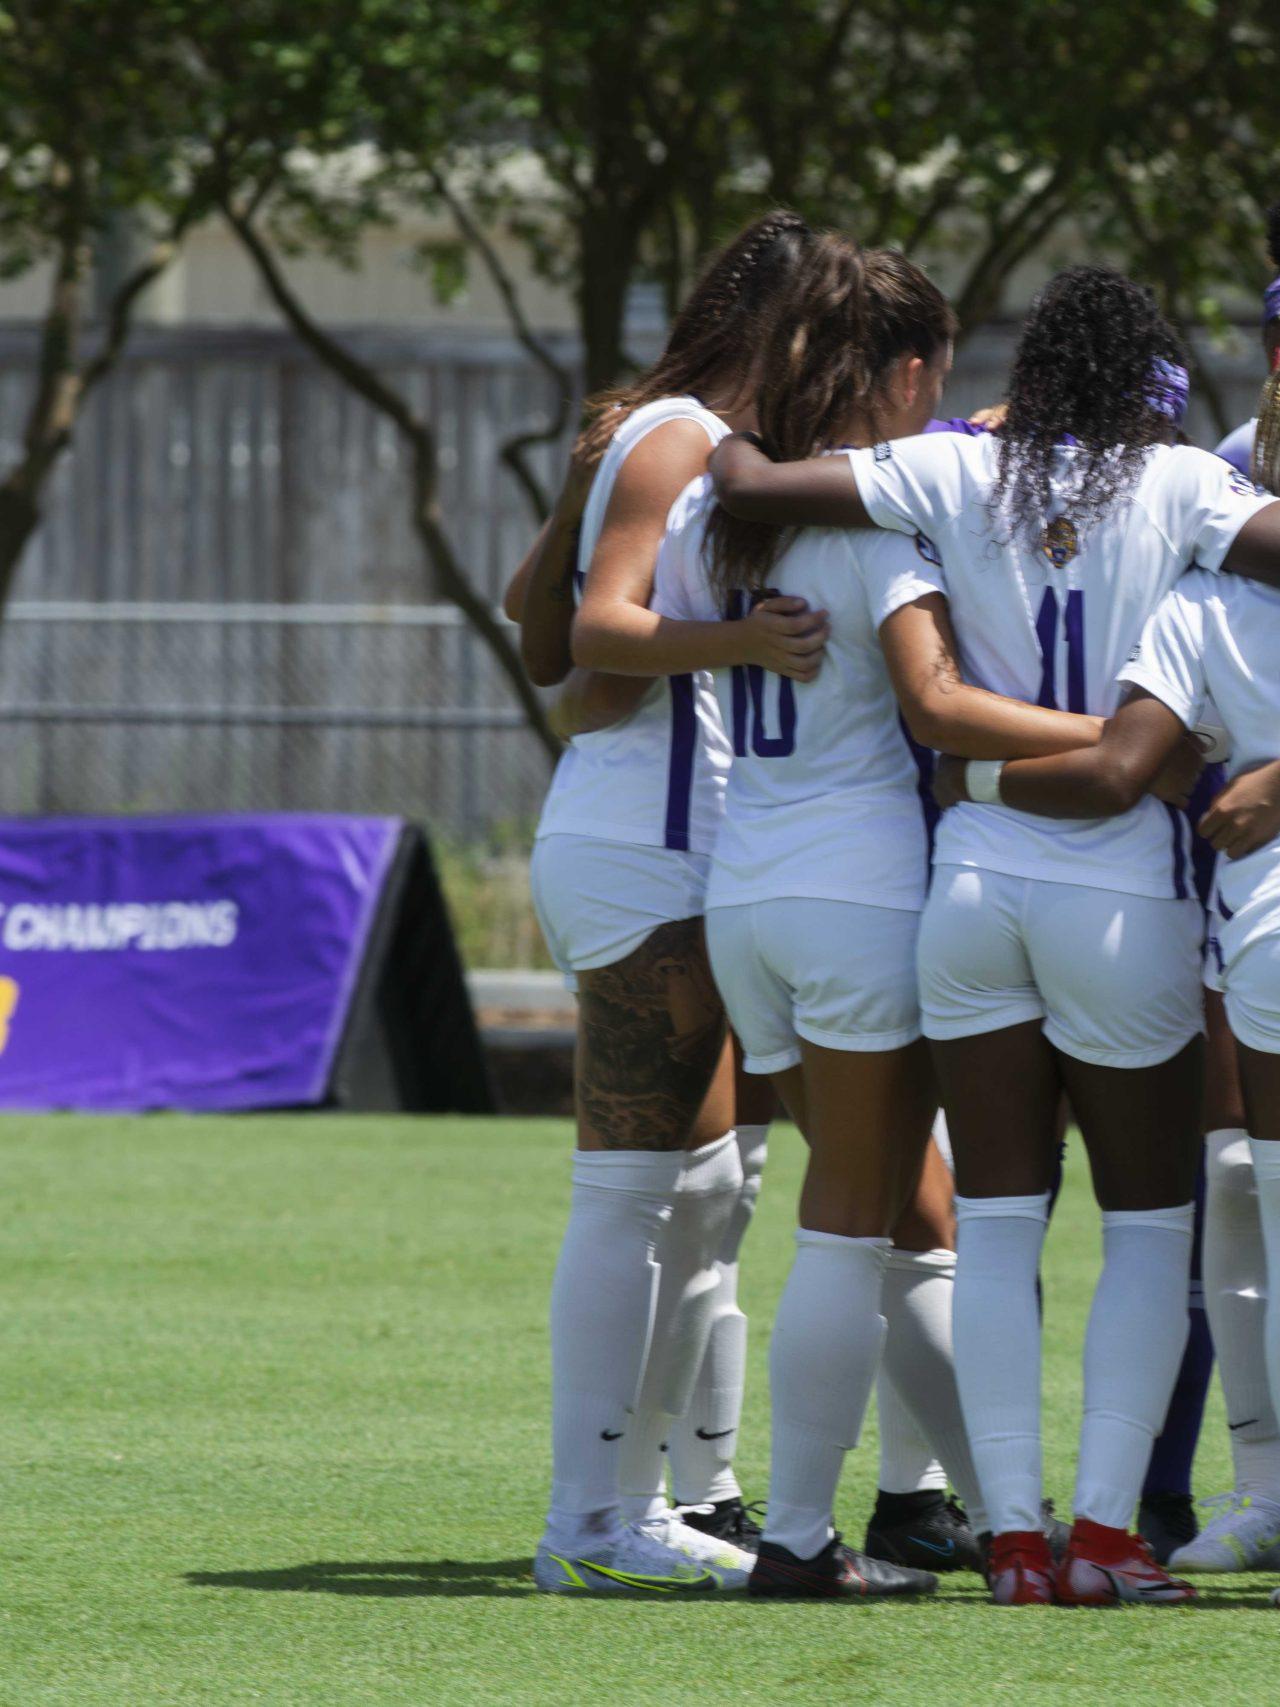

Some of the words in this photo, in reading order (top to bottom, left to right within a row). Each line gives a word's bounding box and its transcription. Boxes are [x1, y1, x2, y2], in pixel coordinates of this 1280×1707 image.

[717, 588, 796, 758] 10
[1036, 585, 1087, 715] 11
[3, 900, 240, 951] CHAMPIONS
